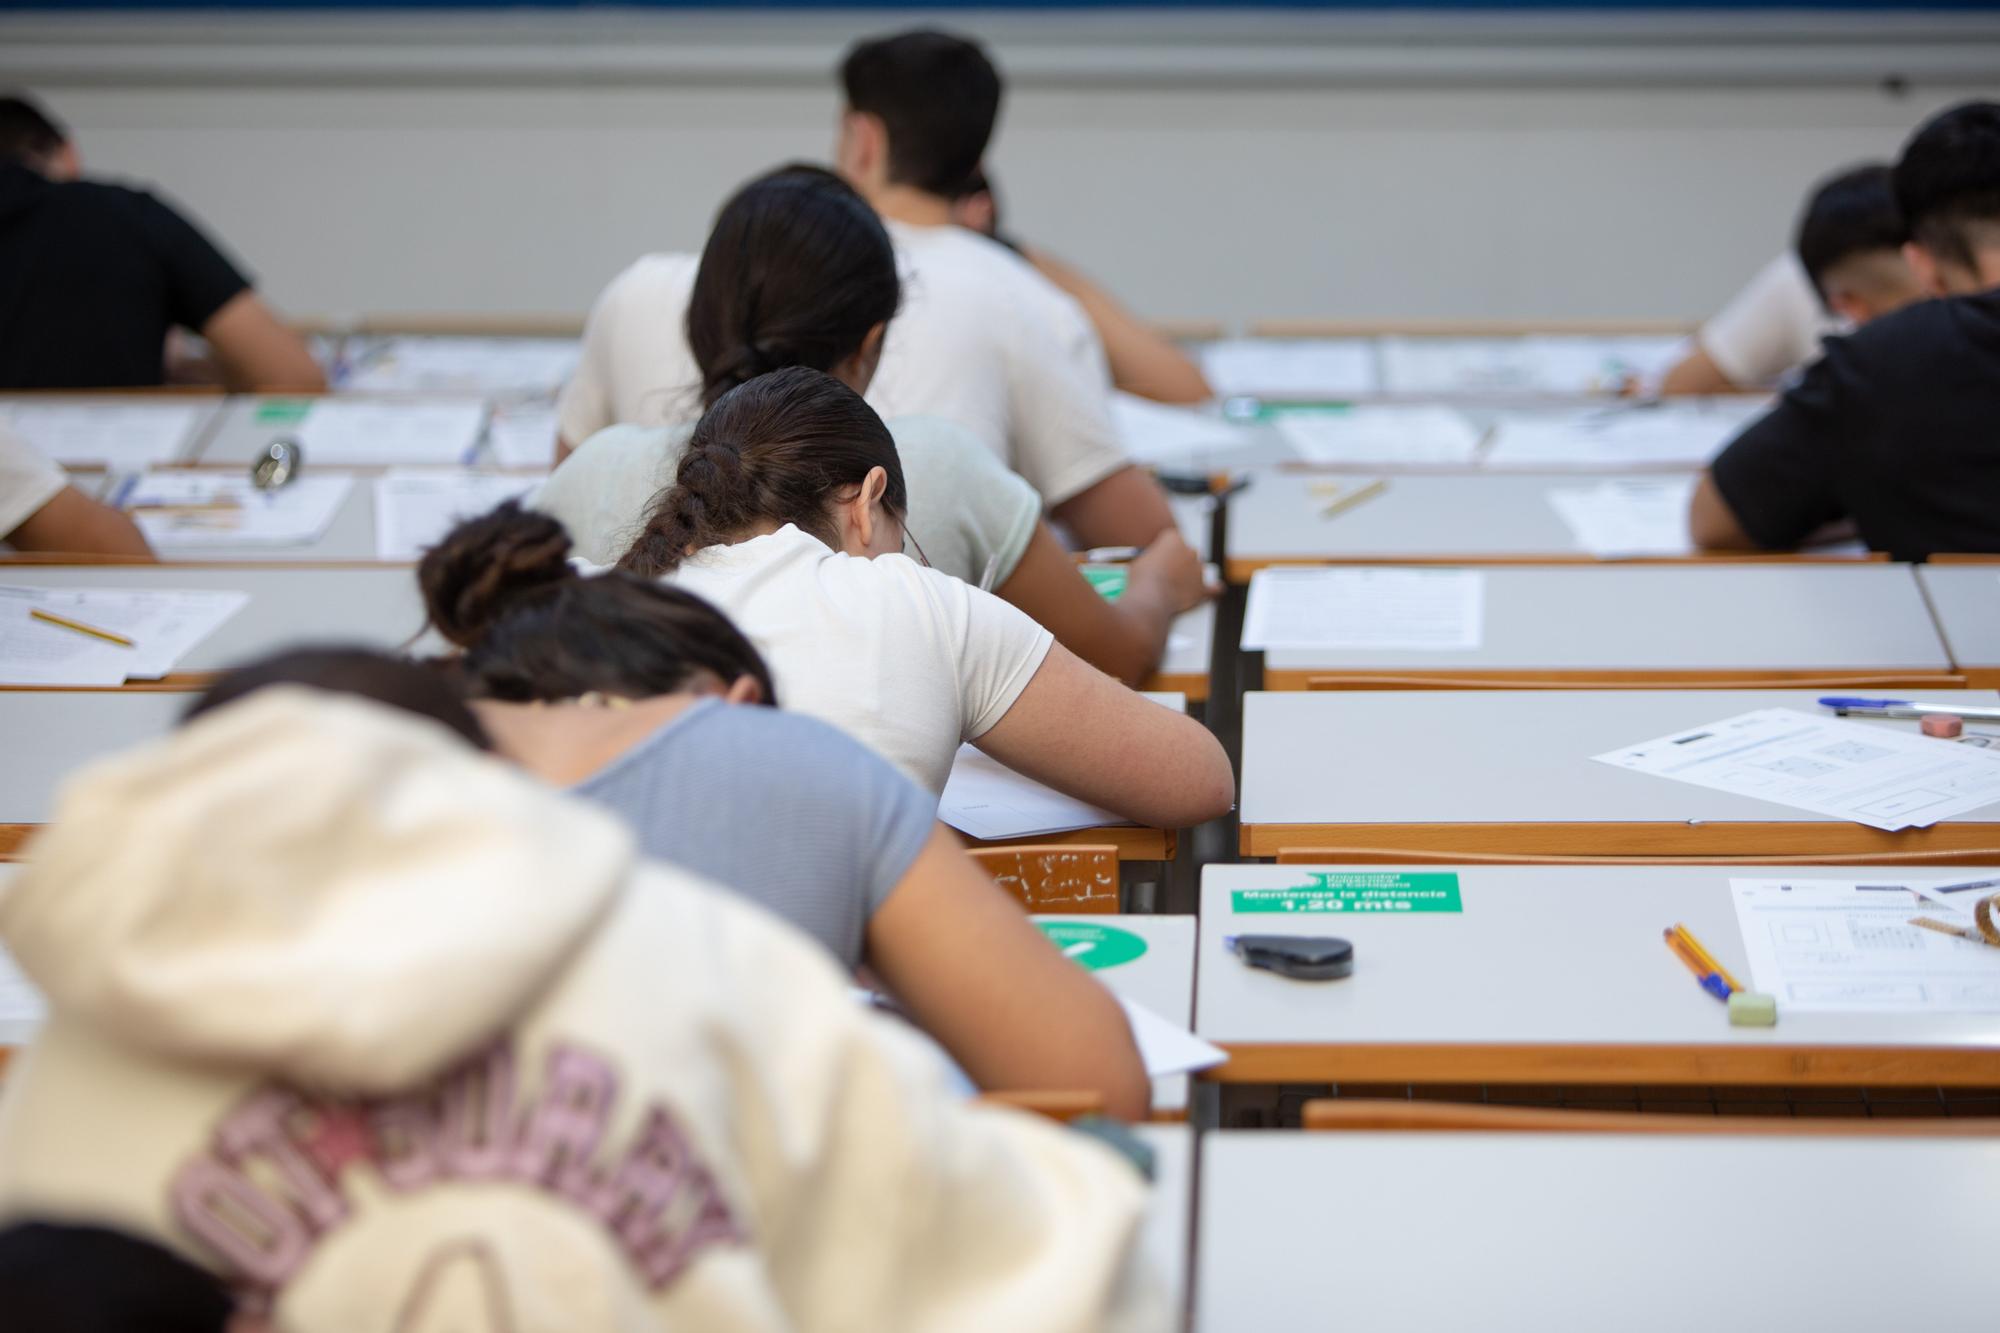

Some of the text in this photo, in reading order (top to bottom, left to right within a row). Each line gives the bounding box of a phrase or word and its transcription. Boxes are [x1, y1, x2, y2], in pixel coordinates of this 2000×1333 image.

[1243, 890, 1447, 900] Mantenga la distancia
[1280, 900, 1412, 911] 1,20 mts
